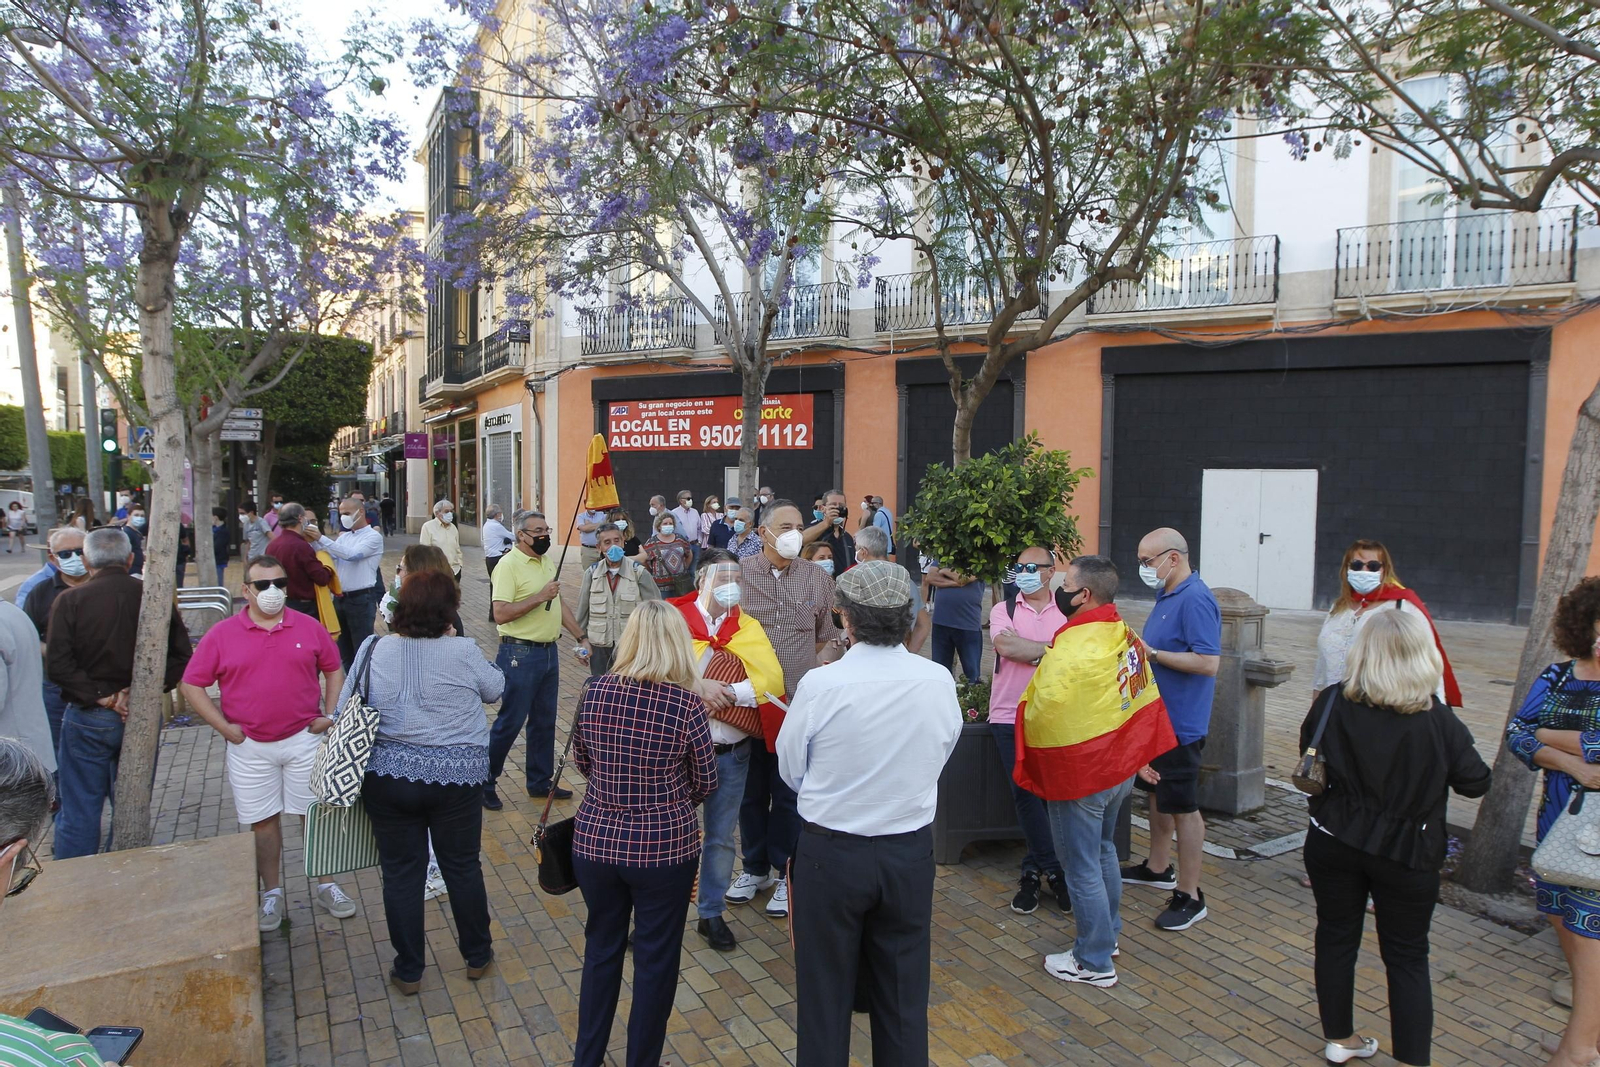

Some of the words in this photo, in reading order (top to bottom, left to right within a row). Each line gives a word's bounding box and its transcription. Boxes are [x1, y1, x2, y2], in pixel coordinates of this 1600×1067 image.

[648, 402, 664, 410] gran
[665, 401, 693, 409] negocio
[641, 410, 657, 419] gran
[658, 409, 675, 417] local
[611, 419, 663, 433] LOCAL
[668, 418, 690, 431] EN
[610, 434, 692, 448] ALQUILER
[699, 423, 807, 447] 95021112
